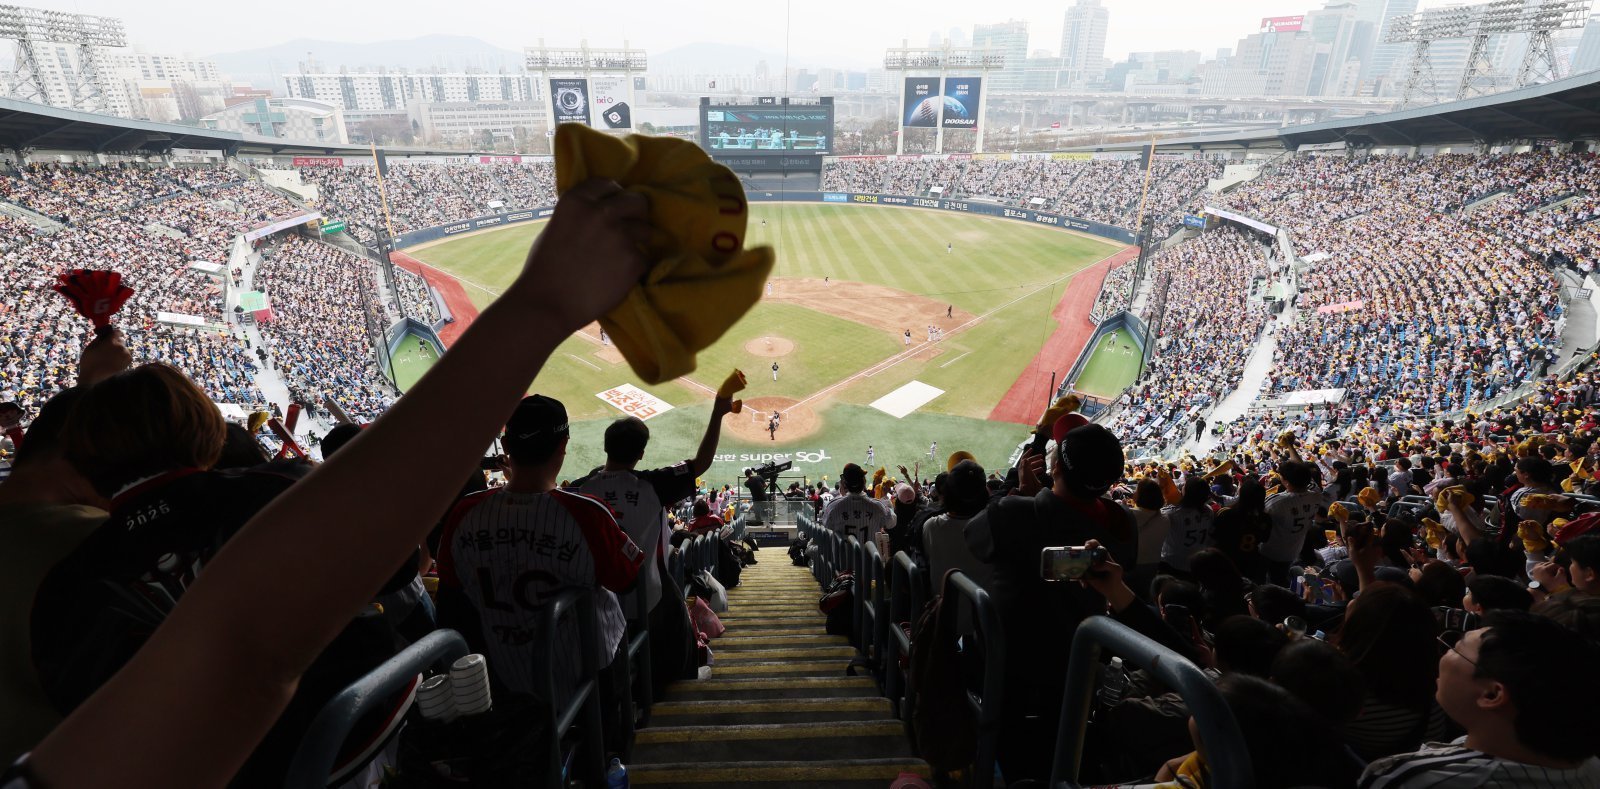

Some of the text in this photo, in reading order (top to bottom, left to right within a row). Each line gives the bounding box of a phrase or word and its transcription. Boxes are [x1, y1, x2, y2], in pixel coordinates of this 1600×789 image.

[854, 195, 878, 203] 대방건설
[944, 201, 968, 211] 금천미트
[740, 452, 792, 463] super
[795, 449, 831, 463] SOL
[844, 525, 869, 544] 51
[1183, 529, 1208, 547] 51
[1240, 534, 1255, 552] 8
